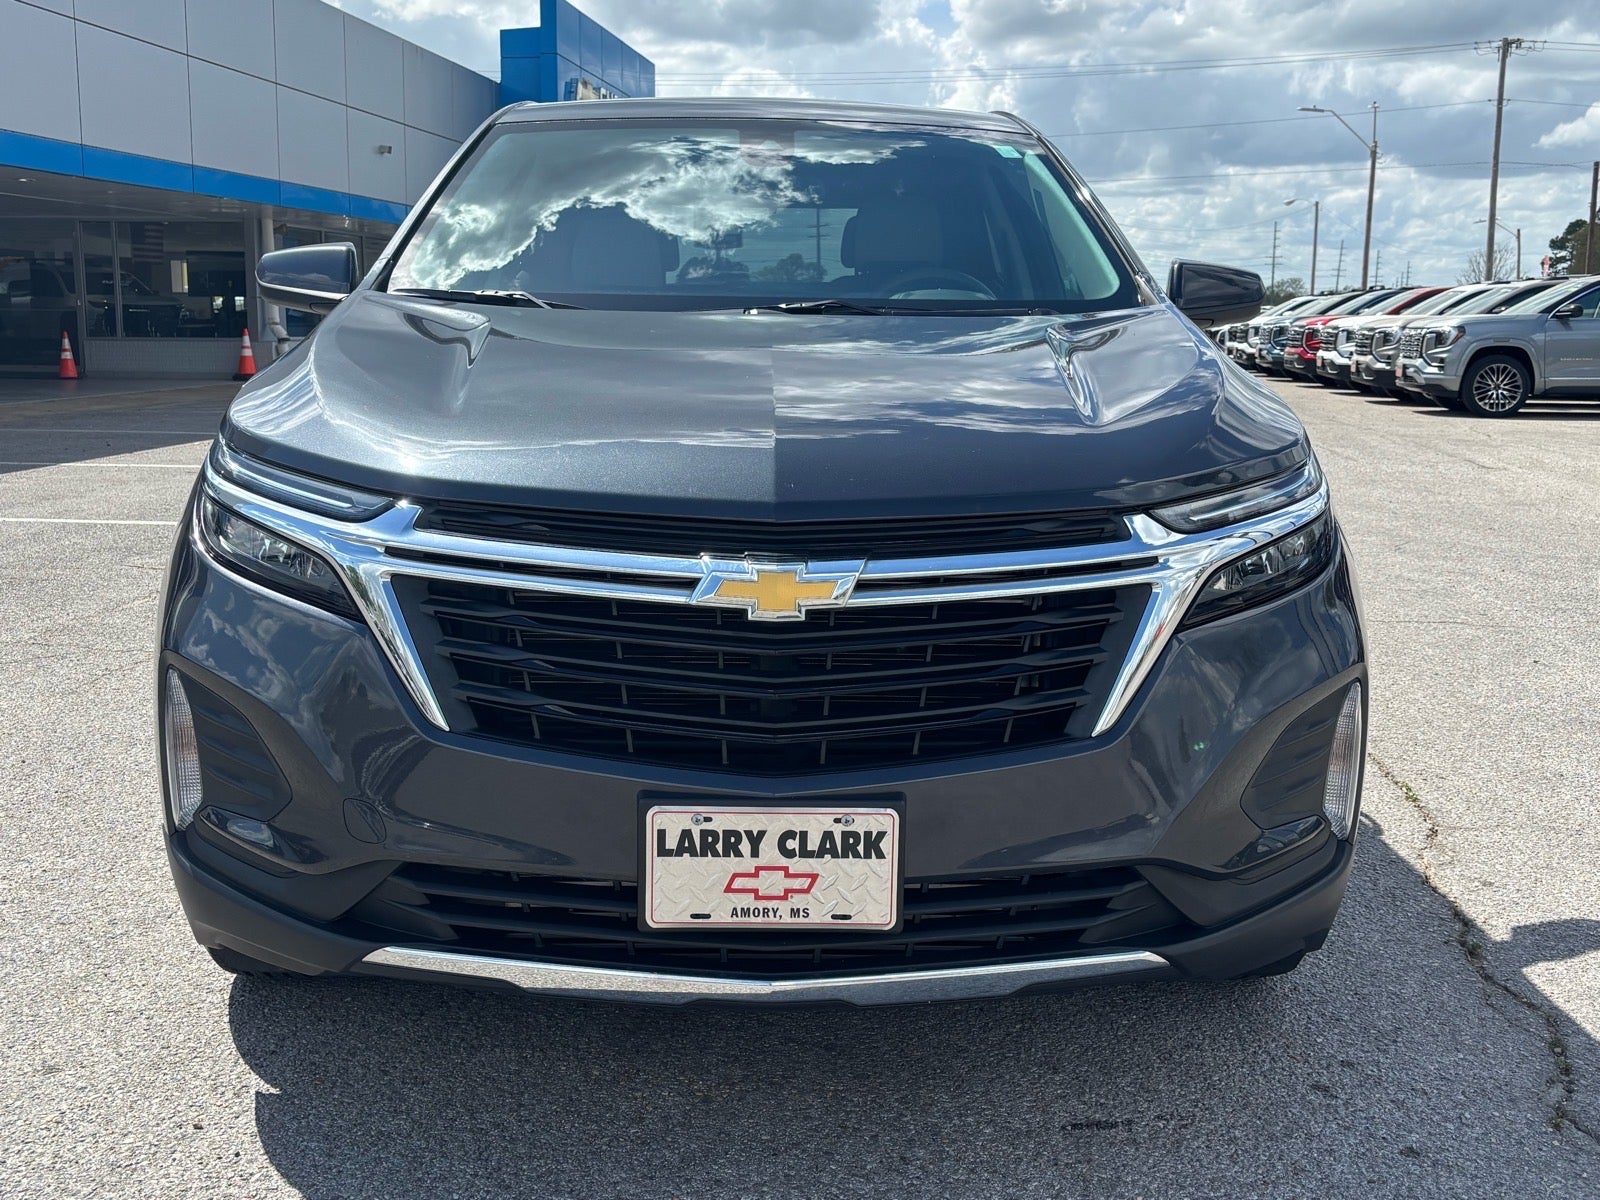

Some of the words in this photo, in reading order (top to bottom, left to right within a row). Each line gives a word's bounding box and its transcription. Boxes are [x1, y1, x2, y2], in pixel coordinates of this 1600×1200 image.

[656, 828, 768, 858] LARRY
[776, 829, 888, 860] CLARK
[730, 906, 783, 921] AMORY,
[789, 907, 811, 919] MS
